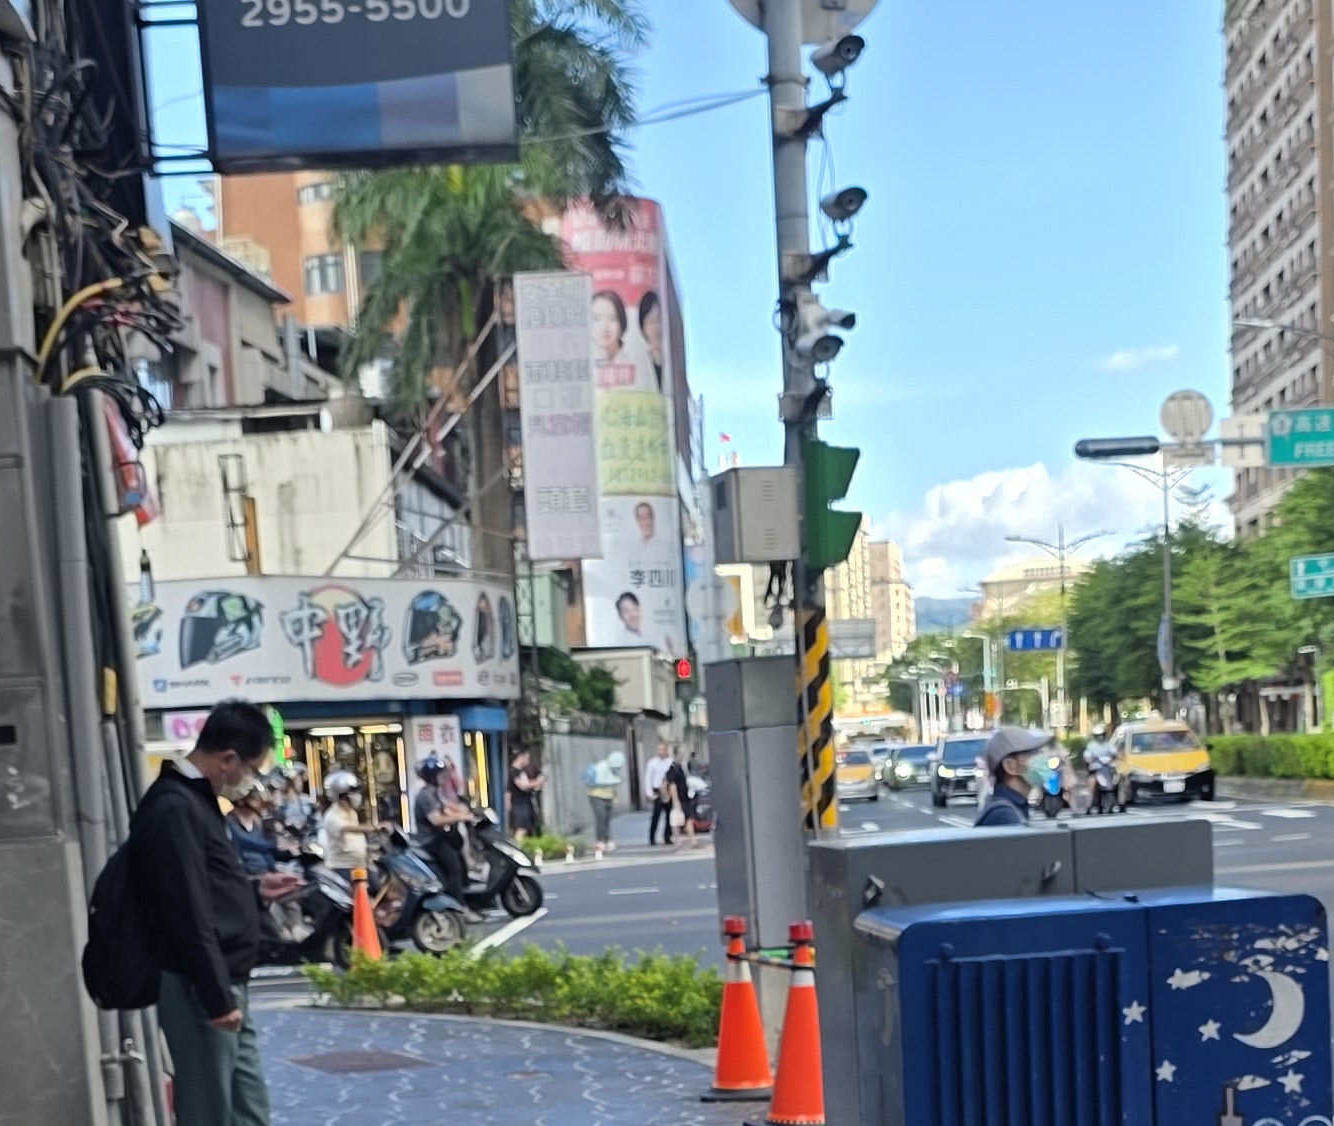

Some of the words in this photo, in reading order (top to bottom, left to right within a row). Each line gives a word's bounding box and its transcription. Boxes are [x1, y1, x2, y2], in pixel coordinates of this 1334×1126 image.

[241, 0, 470, 27] 2955-5500
[629, 568, 675, 589] 李四川
